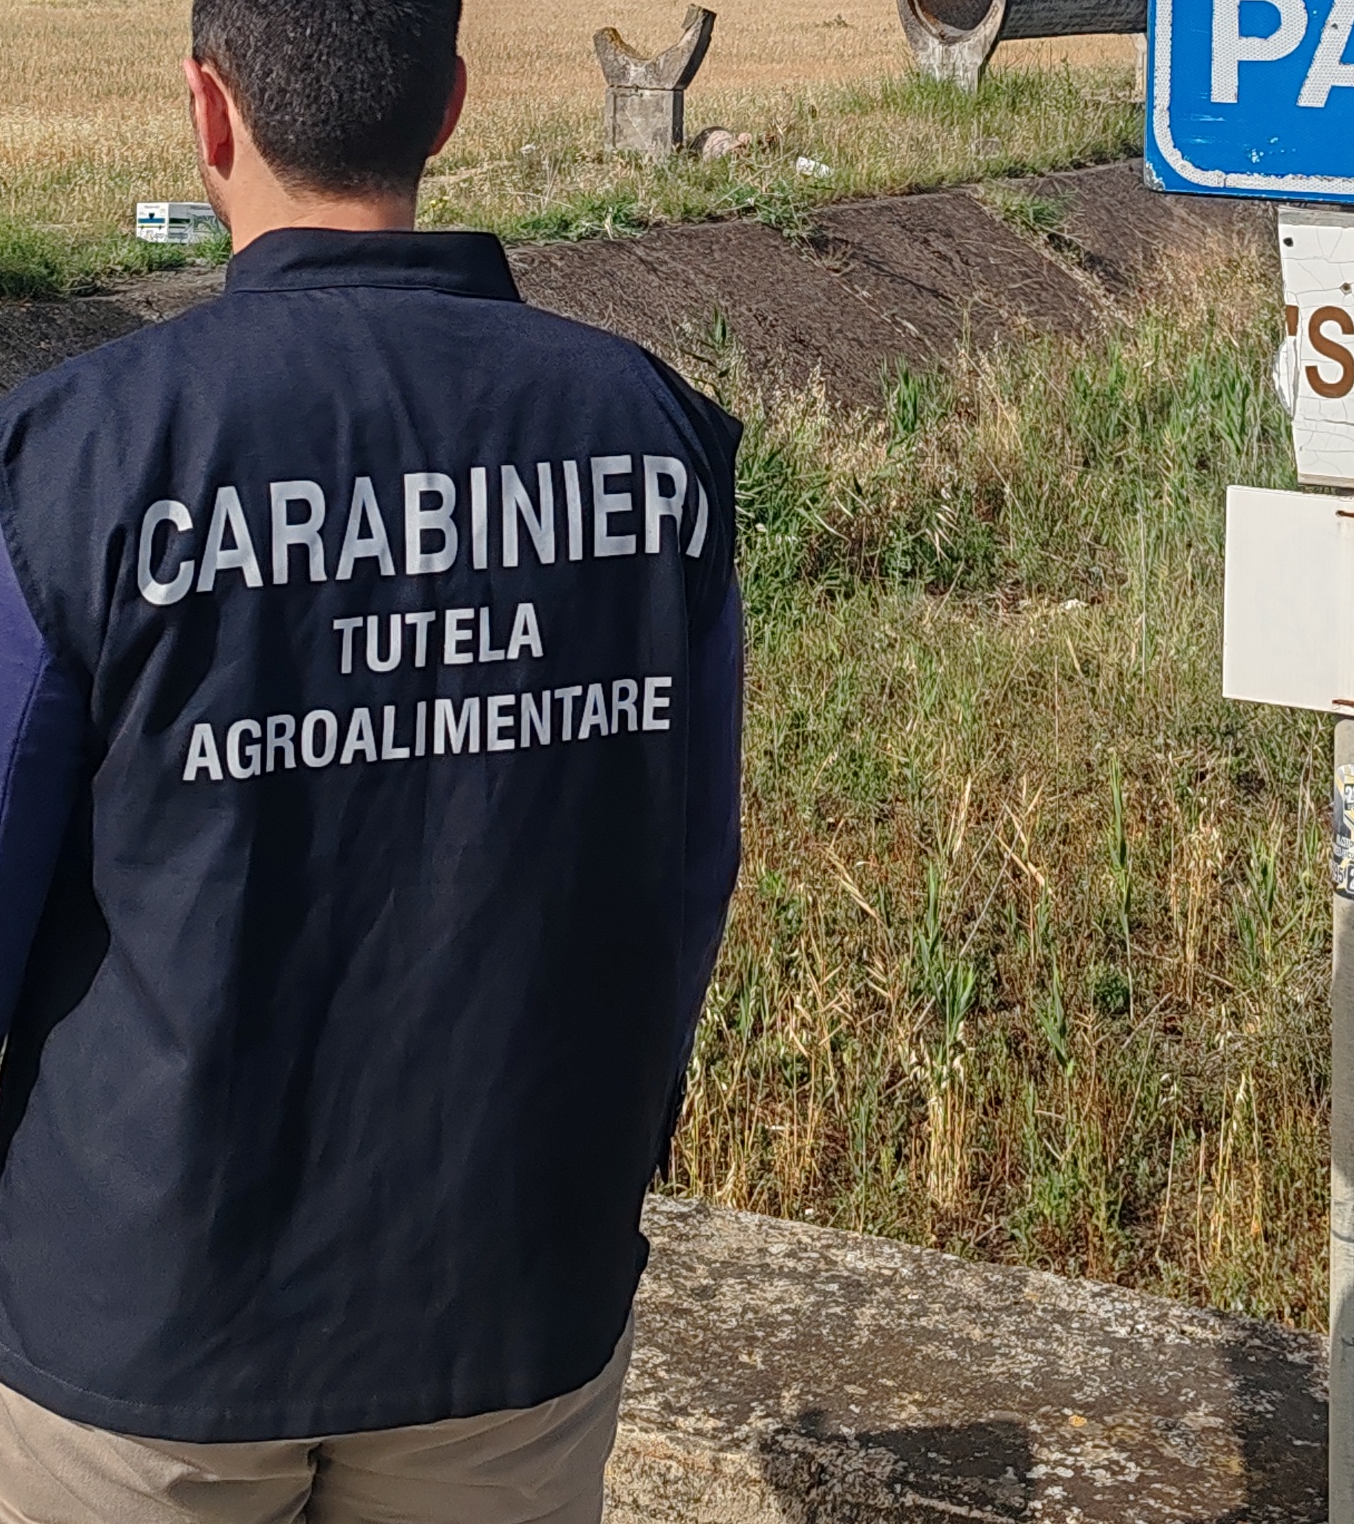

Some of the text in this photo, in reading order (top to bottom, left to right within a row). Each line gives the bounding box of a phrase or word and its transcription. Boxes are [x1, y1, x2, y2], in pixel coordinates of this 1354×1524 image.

[137, 454, 709, 606] CARABINIERI
[333, 602, 544, 674] TUTELA
[182, 676, 673, 782] AGROALIMENTARE
